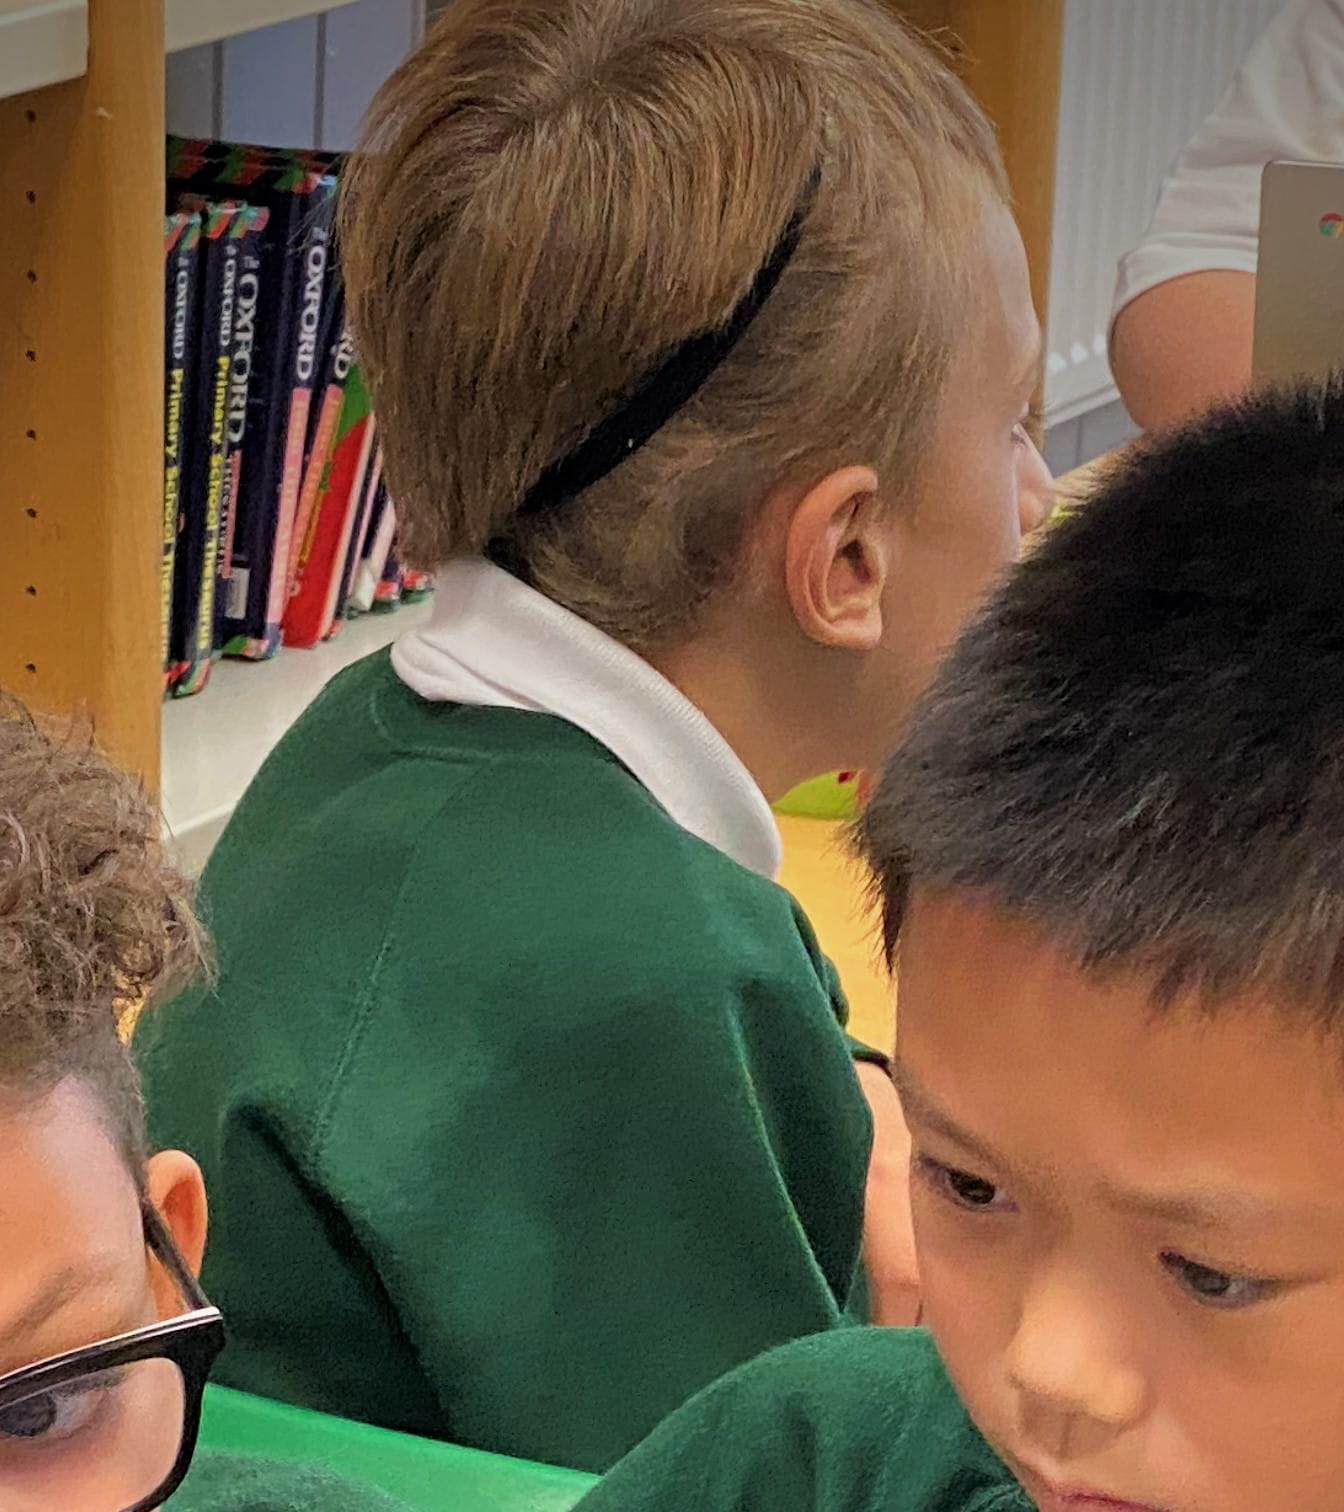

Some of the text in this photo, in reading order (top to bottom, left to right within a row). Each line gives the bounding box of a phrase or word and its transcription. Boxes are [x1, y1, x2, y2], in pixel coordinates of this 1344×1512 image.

[172, 270, 189, 360] OXFORD
[219, 258, 236, 347] OXFORD
[297, 245, 326, 381] OXFORD
[208, 355, 231, 446] Primary
[225, 273, 259, 443] OXFORD
[165, 368, 185, 457] Primary
[205, 453, 226, 531] School
[196, 536, 219, 650] Thesaurus
